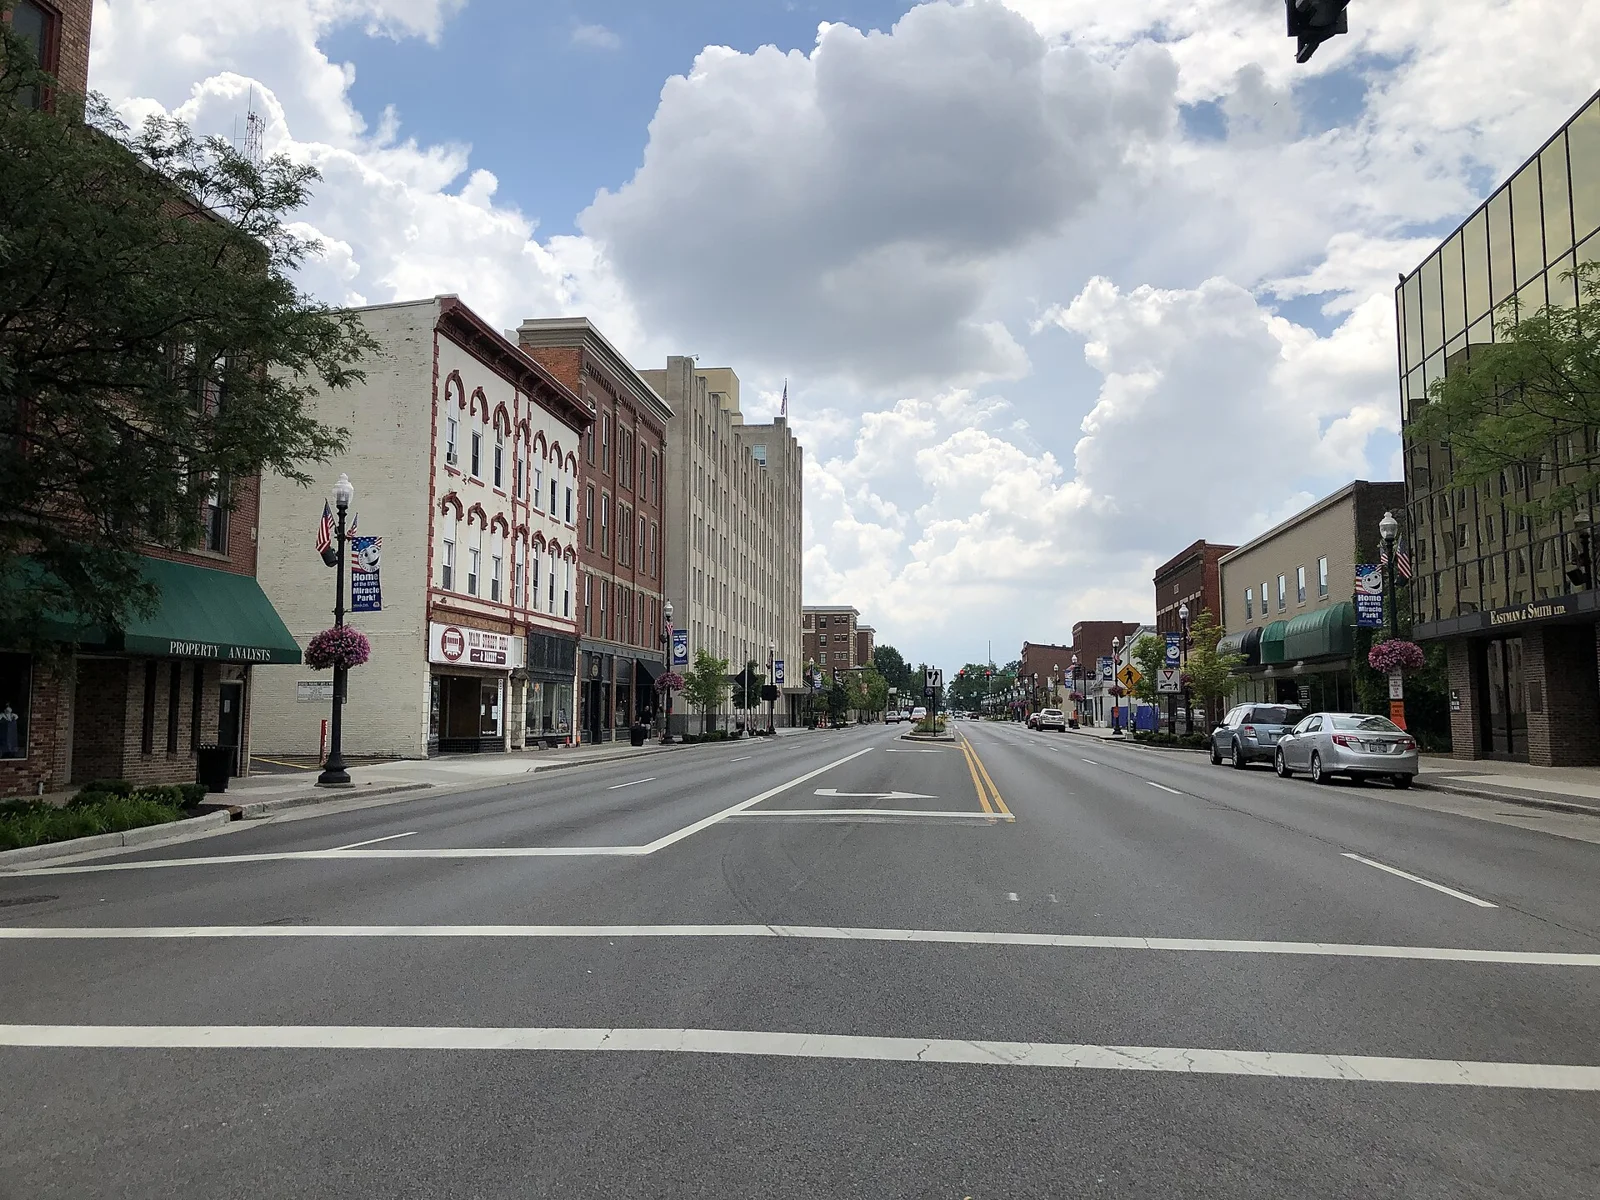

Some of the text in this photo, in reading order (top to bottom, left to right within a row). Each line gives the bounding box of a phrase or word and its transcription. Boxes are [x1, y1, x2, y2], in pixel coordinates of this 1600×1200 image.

[353, 573, 378, 581] Home
[1490, 610, 1520, 625] EASTMAN
[1521, 609, 1526, 620] &
[1527, 603, 1552, 619] SMITH
[482, 634, 497, 649] STREET
[169, 641, 271, 661] PROPERTY ANALYSTS
